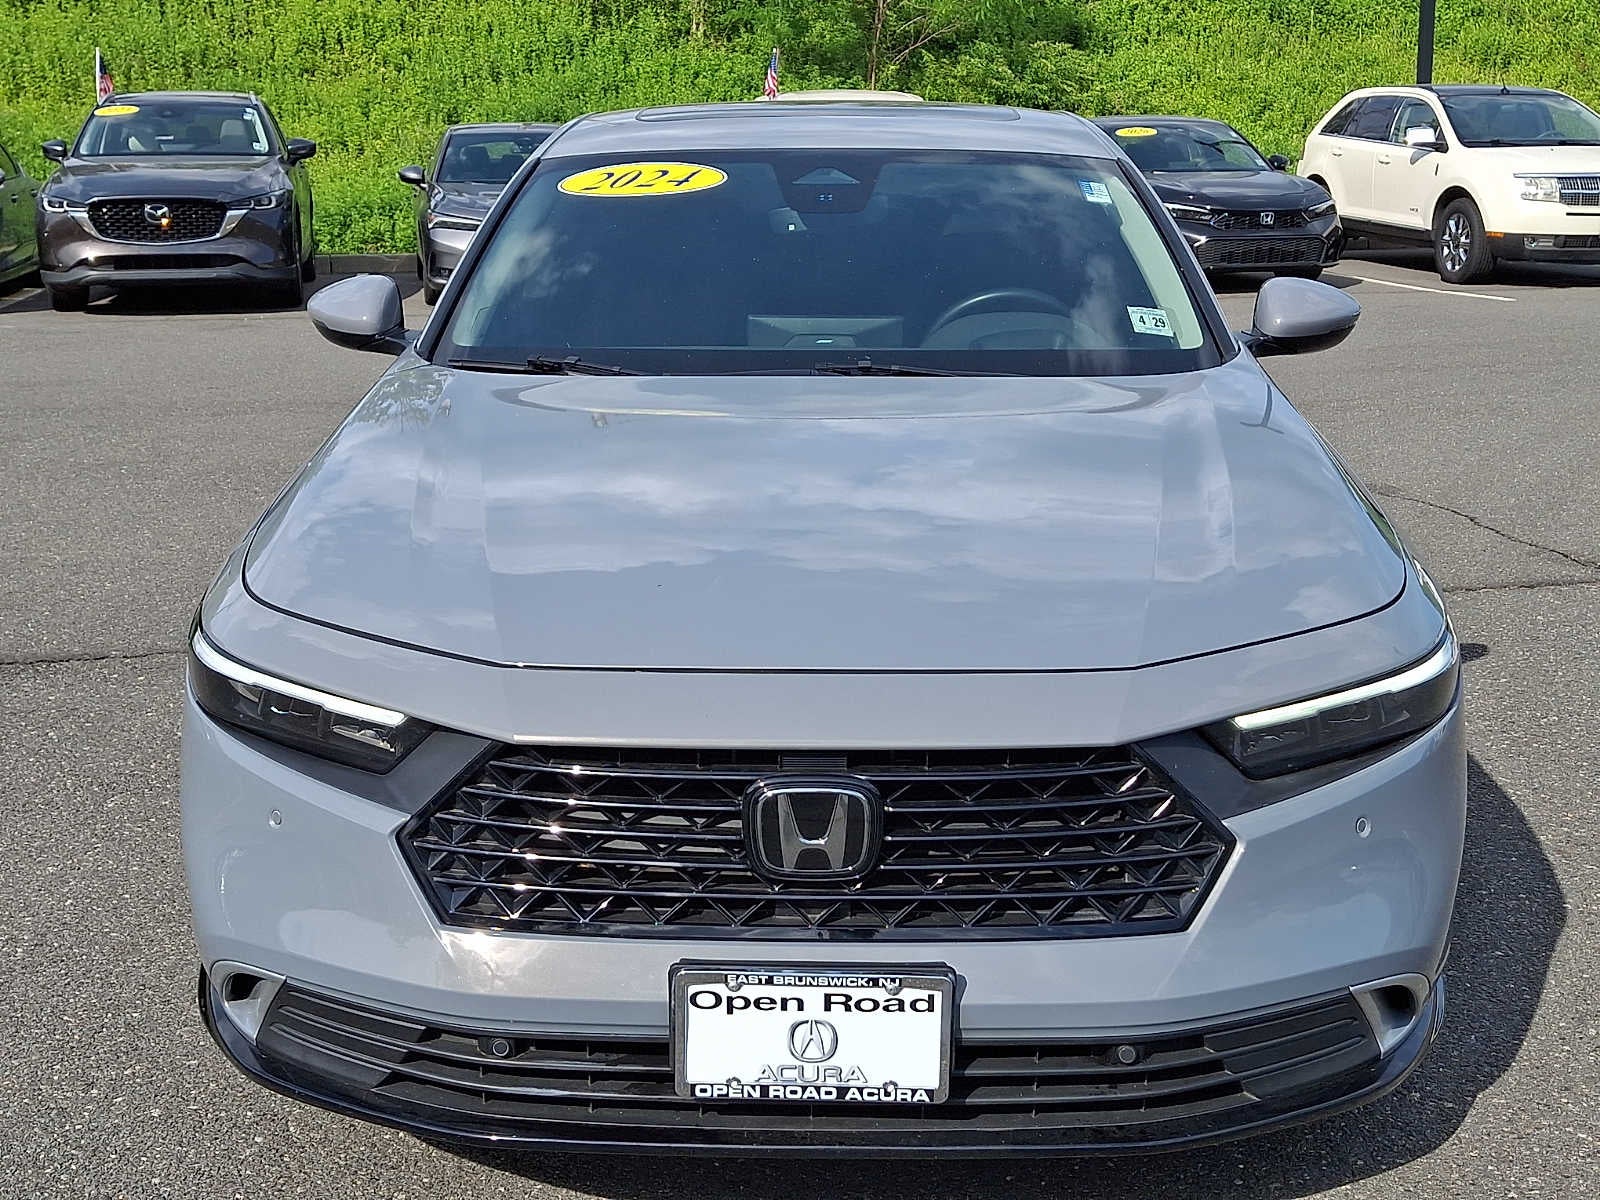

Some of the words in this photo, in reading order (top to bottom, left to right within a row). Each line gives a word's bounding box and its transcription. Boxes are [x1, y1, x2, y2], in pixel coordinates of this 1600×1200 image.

[580, 169, 702, 191] 2024
[1138, 315, 1146, 326] 4
[1151, 316, 1166, 328] 29
[726, 974, 769, 985] EAST
[773, 975, 873, 987] BRUNSWICK,
[878, 977, 901, 989] NJ
[689, 990, 805, 1015] Open
[823, 992, 935, 1013] Road
[755, 1064, 868, 1084] ACURA
[694, 1084, 761, 1098] OPEN
[768, 1085, 838, 1100] ROAD
[844, 1087, 931, 1103] ACURA
